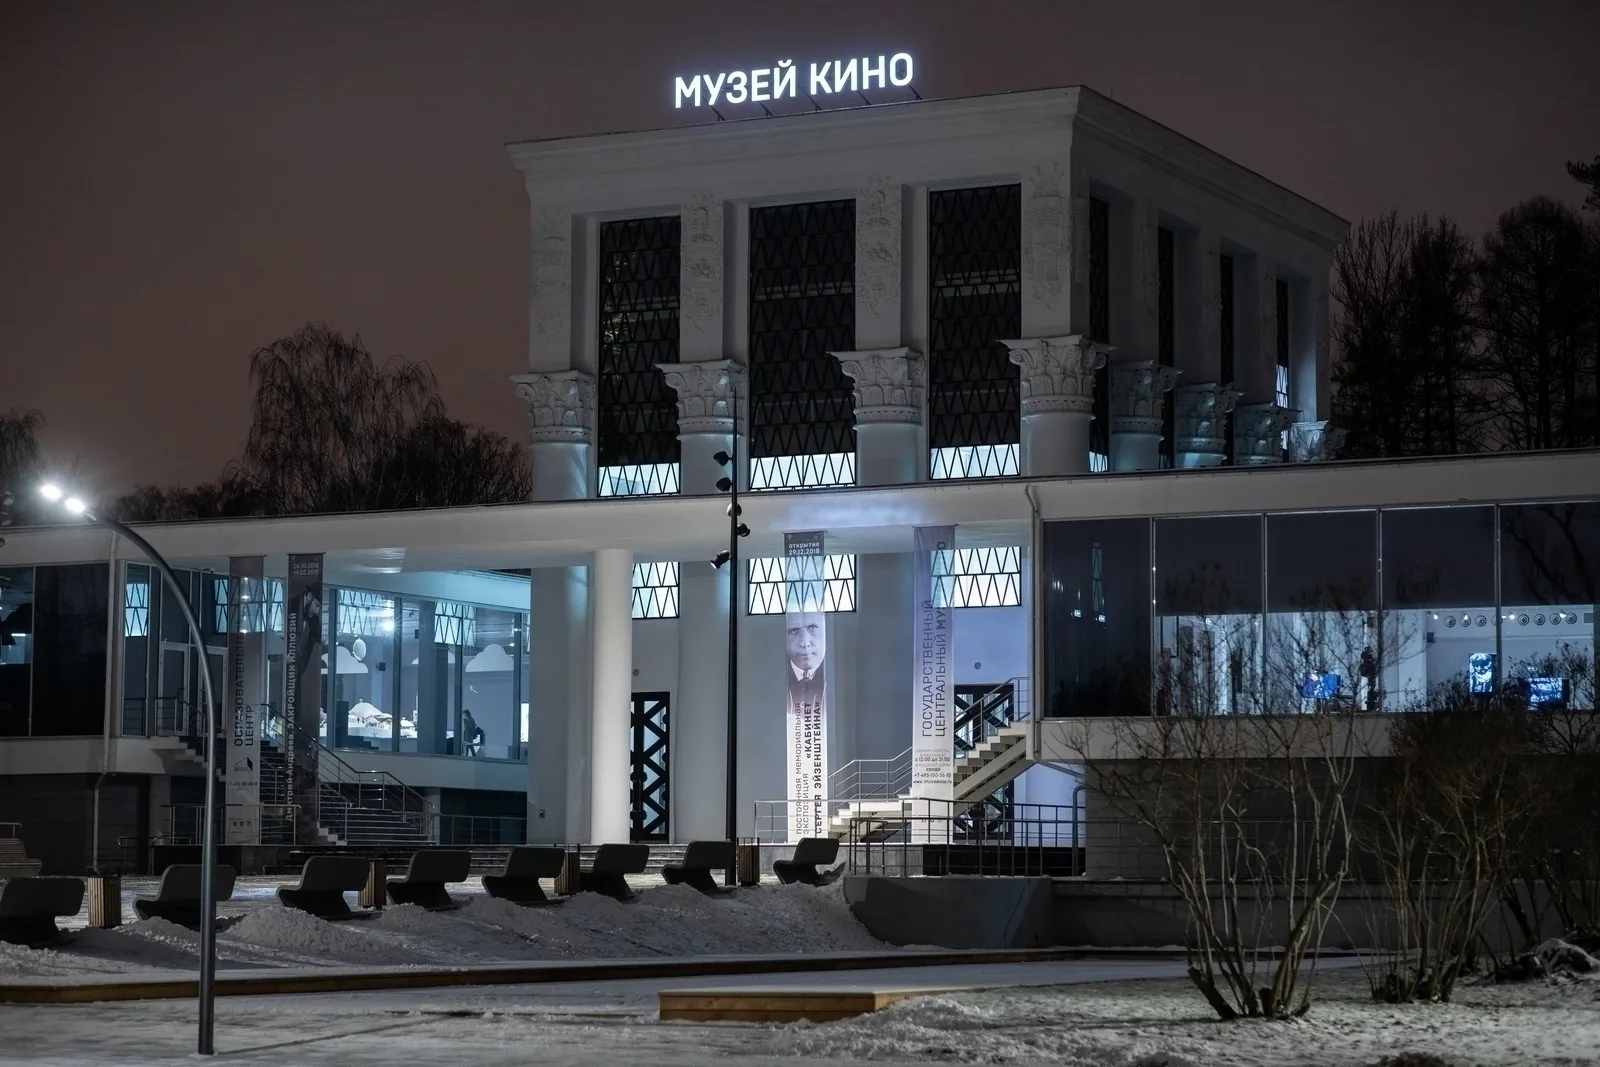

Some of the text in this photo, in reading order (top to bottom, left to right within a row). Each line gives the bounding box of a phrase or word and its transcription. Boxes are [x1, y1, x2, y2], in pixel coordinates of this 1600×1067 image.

[675, 52, 914, 108] МУЗЕЙ КИНО
[788, 548, 820, 556] 29.12.2018
[287, 664, 296, 729] ЗАКРОЙЩИК
[921, 600, 935, 737] ГОСУДАРСТВЕННЫЙ
[934, 633, 946, 737] ЦЕНТРАЛЬНЫЙ
[245, 705, 254, 747] ЦЕНТР
[804, 702, 812, 758] «КАБИНЕТ
[812, 701, 822, 789] ЭЙЗЕНШТЕЙНА»
